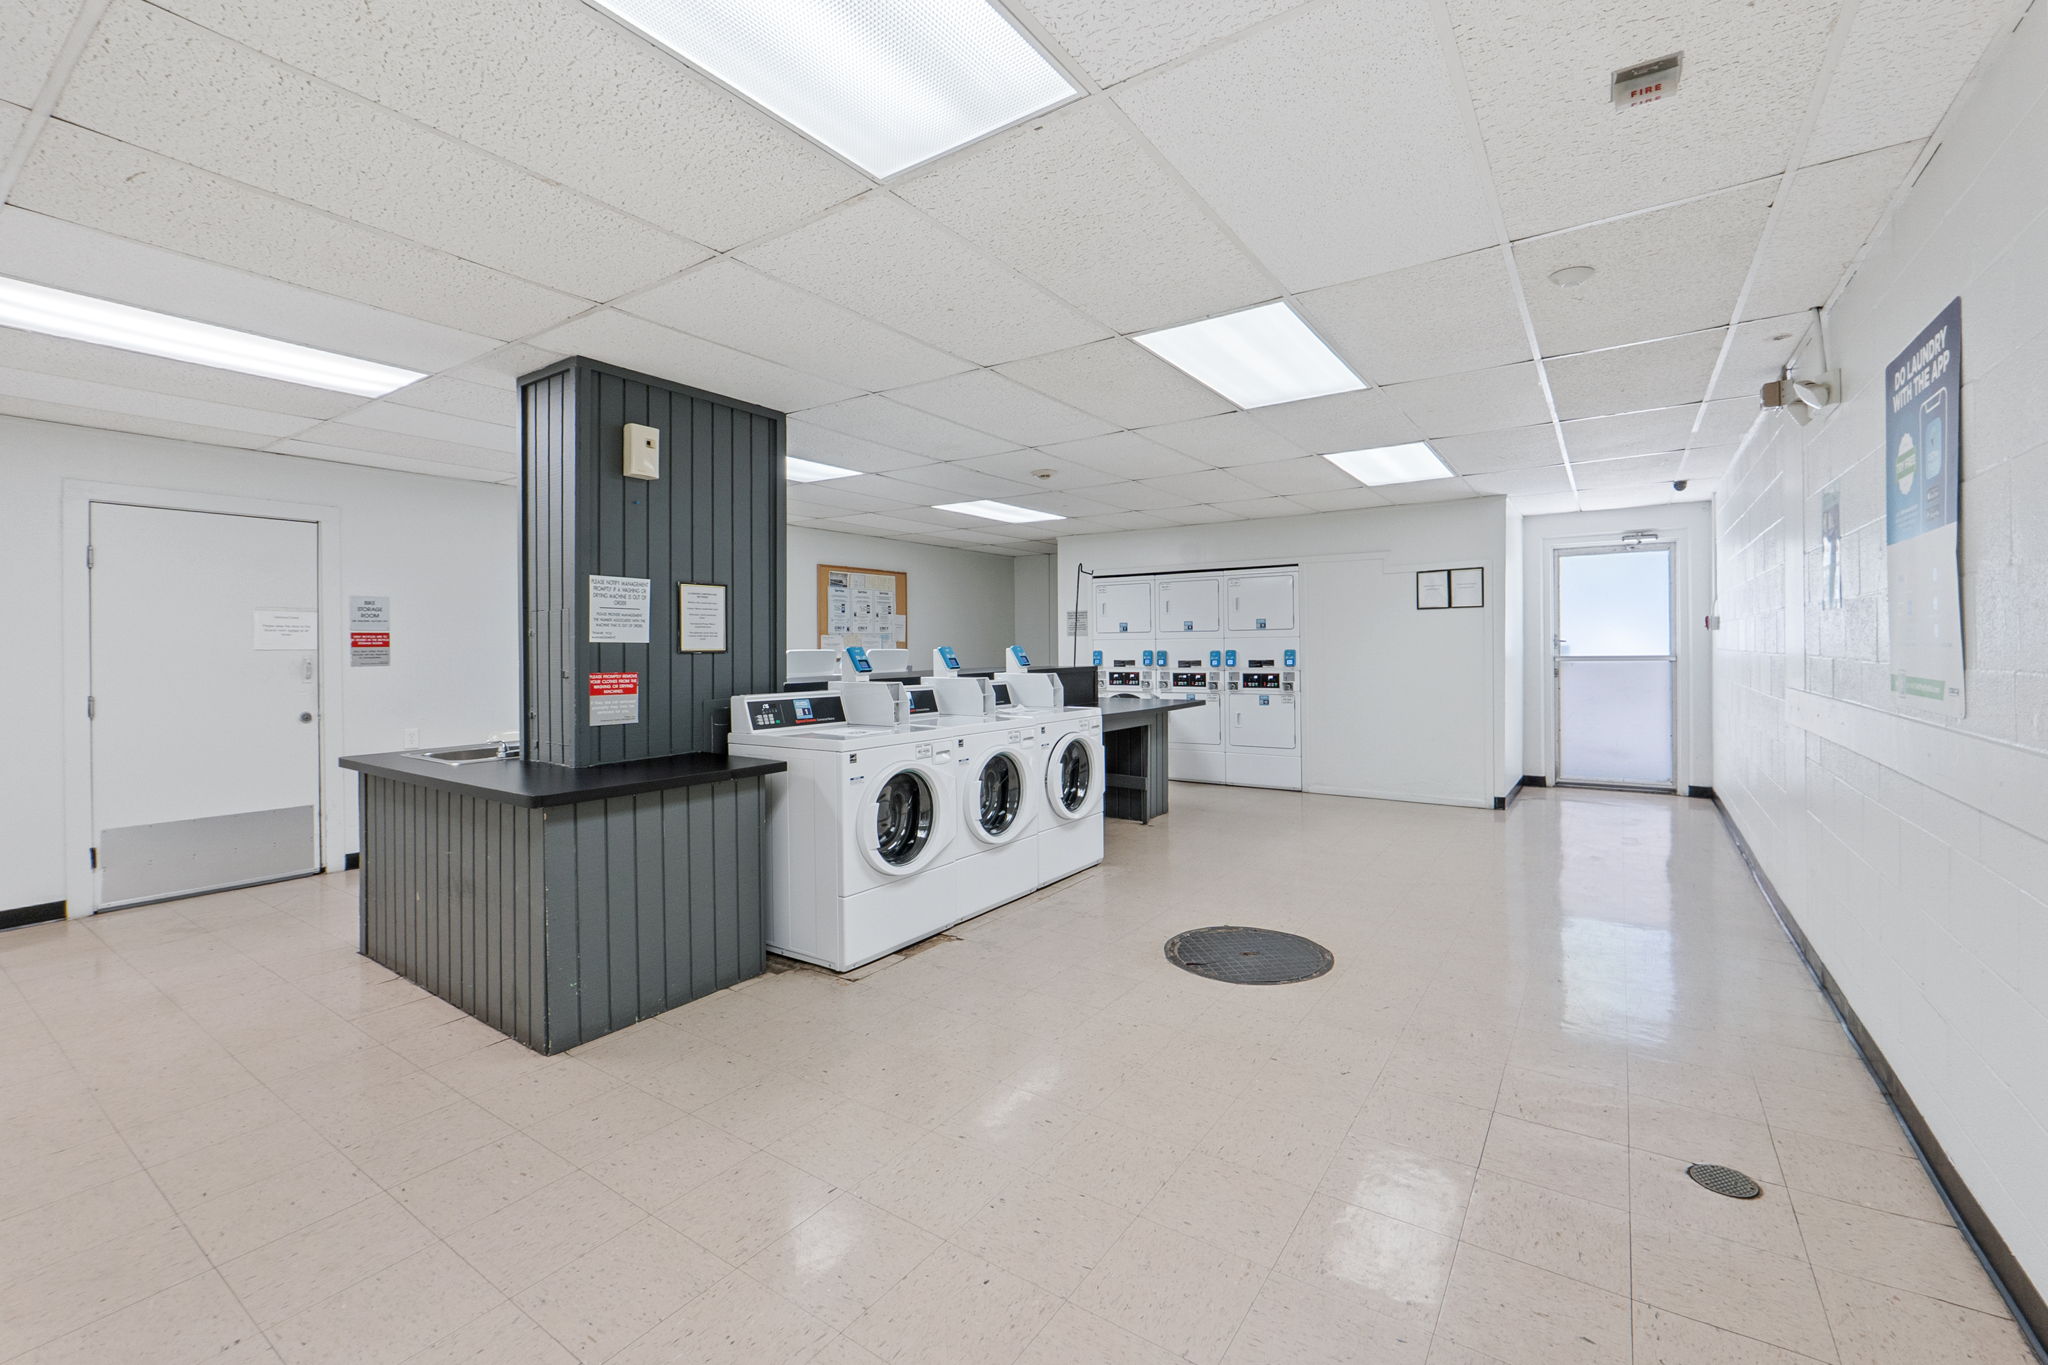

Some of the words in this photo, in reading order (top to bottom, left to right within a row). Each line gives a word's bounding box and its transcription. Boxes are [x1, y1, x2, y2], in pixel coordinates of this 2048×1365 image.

[1630, 84, 1662, 98] FIRE
[1892, 381, 1913, 413] WITH
[1913, 366, 1930, 396] THE
[1931, 350, 1950, 383] APP
[1894, 366, 1906, 391] DO
[1906, 325, 1948, 380] LAUNDRY
